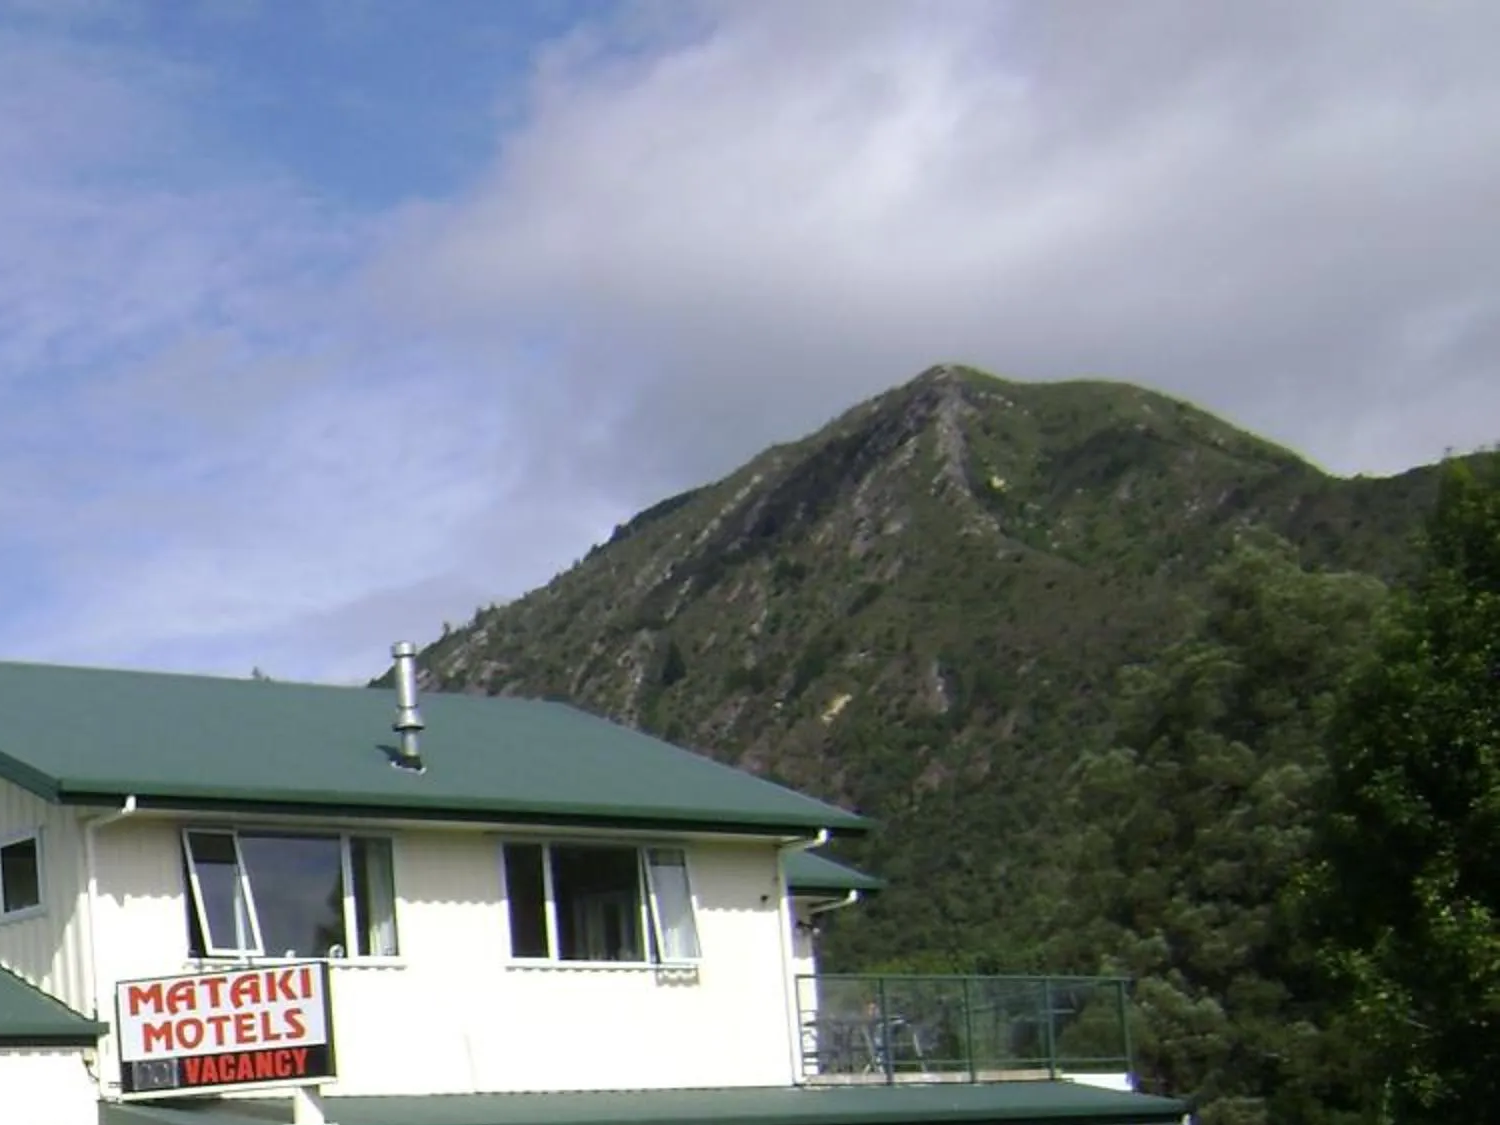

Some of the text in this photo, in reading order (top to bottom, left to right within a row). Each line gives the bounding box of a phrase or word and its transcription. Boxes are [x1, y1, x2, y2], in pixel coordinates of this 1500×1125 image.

[127, 967, 313, 1016] MATAKI
[142, 1007, 307, 1053] MOTELS
[183, 1047, 309, 1084] VACANCY
